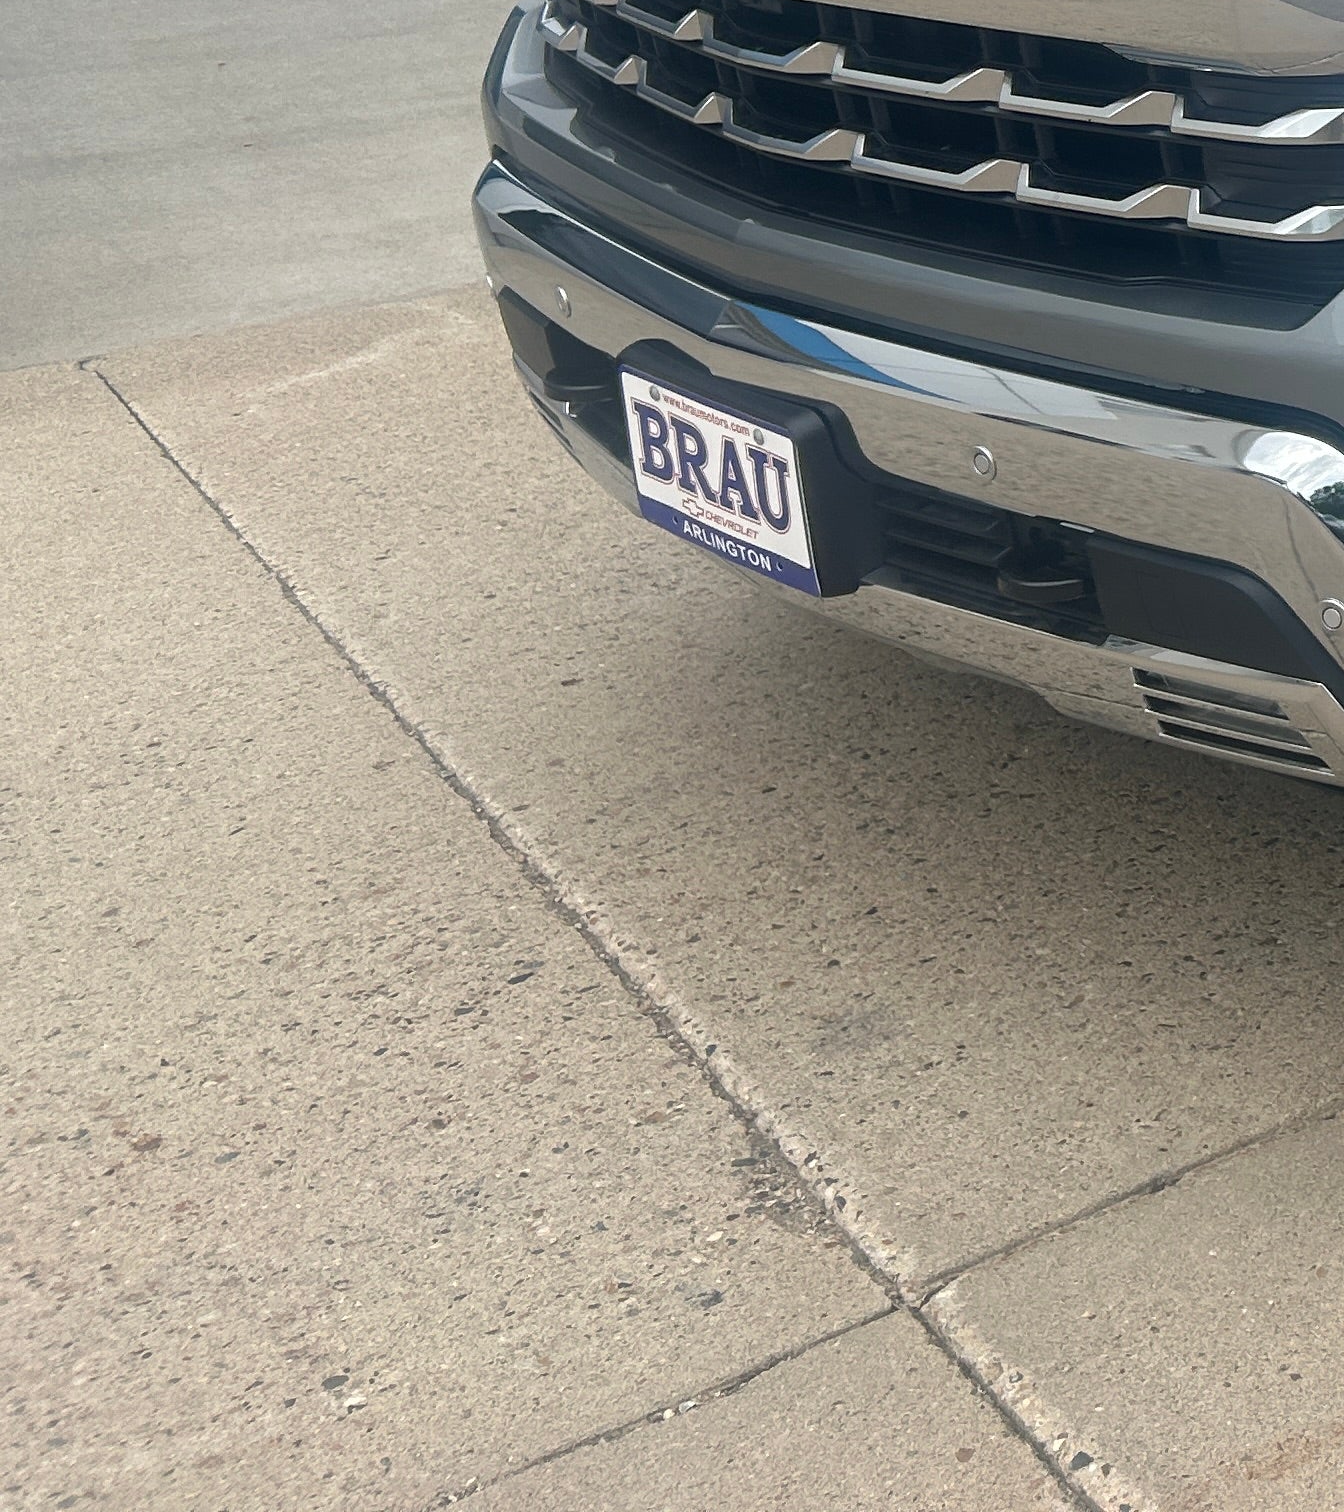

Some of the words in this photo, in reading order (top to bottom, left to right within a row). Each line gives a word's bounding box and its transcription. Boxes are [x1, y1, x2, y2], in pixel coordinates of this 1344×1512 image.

[630, 396, 792, 534] BRAU
[683, 519, 772, 572] ARLINGTON
[706, 510, 759, 540] CHEVROLET
